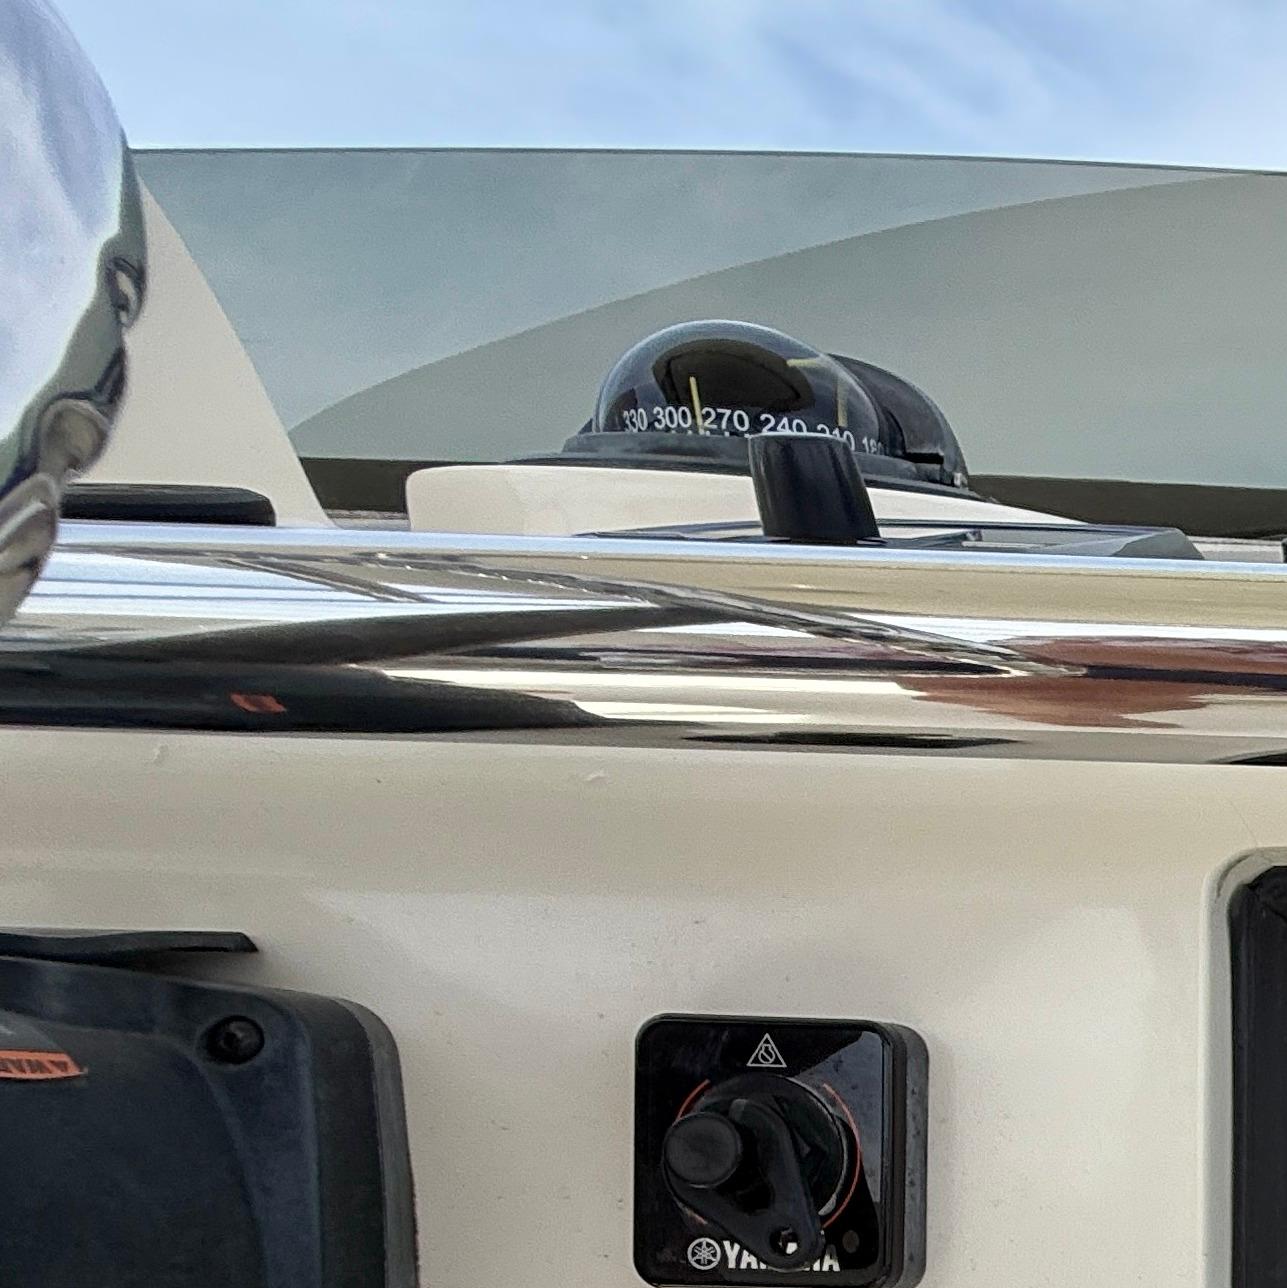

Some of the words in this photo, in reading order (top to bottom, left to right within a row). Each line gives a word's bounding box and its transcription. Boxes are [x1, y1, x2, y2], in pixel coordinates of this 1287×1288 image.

[653, 406, 692, 429] 300
[701, 407, 749, 431] 270
[760, 414, 806, 433] 240
[722, 1240, 840, 1272] YAA
